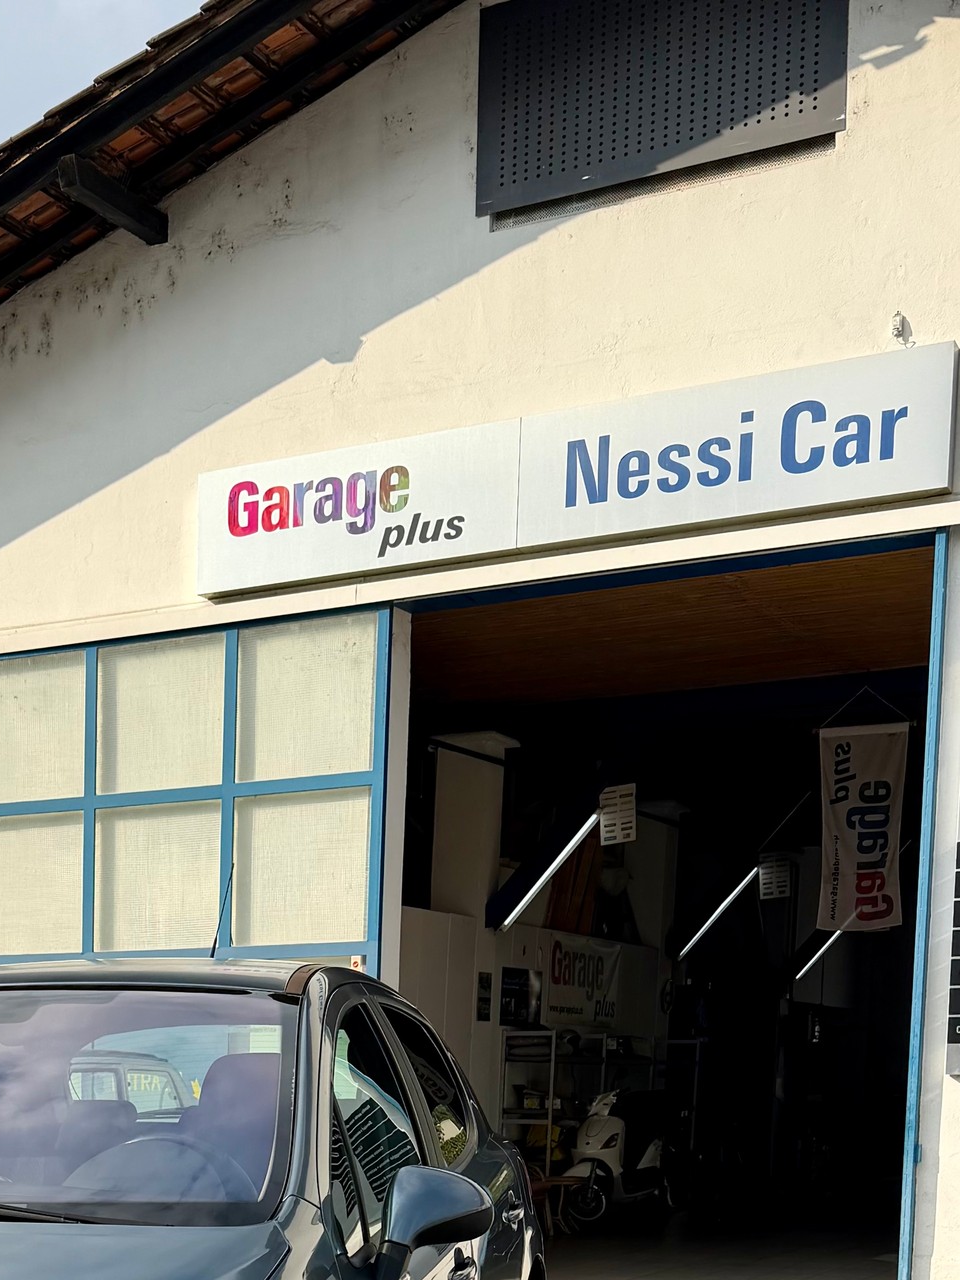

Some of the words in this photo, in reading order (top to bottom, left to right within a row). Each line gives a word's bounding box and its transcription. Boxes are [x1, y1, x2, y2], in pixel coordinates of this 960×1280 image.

[565, 411, 753, 508] Nessi
[780, 400, 909, 474] Car
[227, 464, 410, 537] Garage
[377, 510, 465, 557] plus
[551, 940, 604, 1001] Garage
[594, 994, 616, 1021] plus
